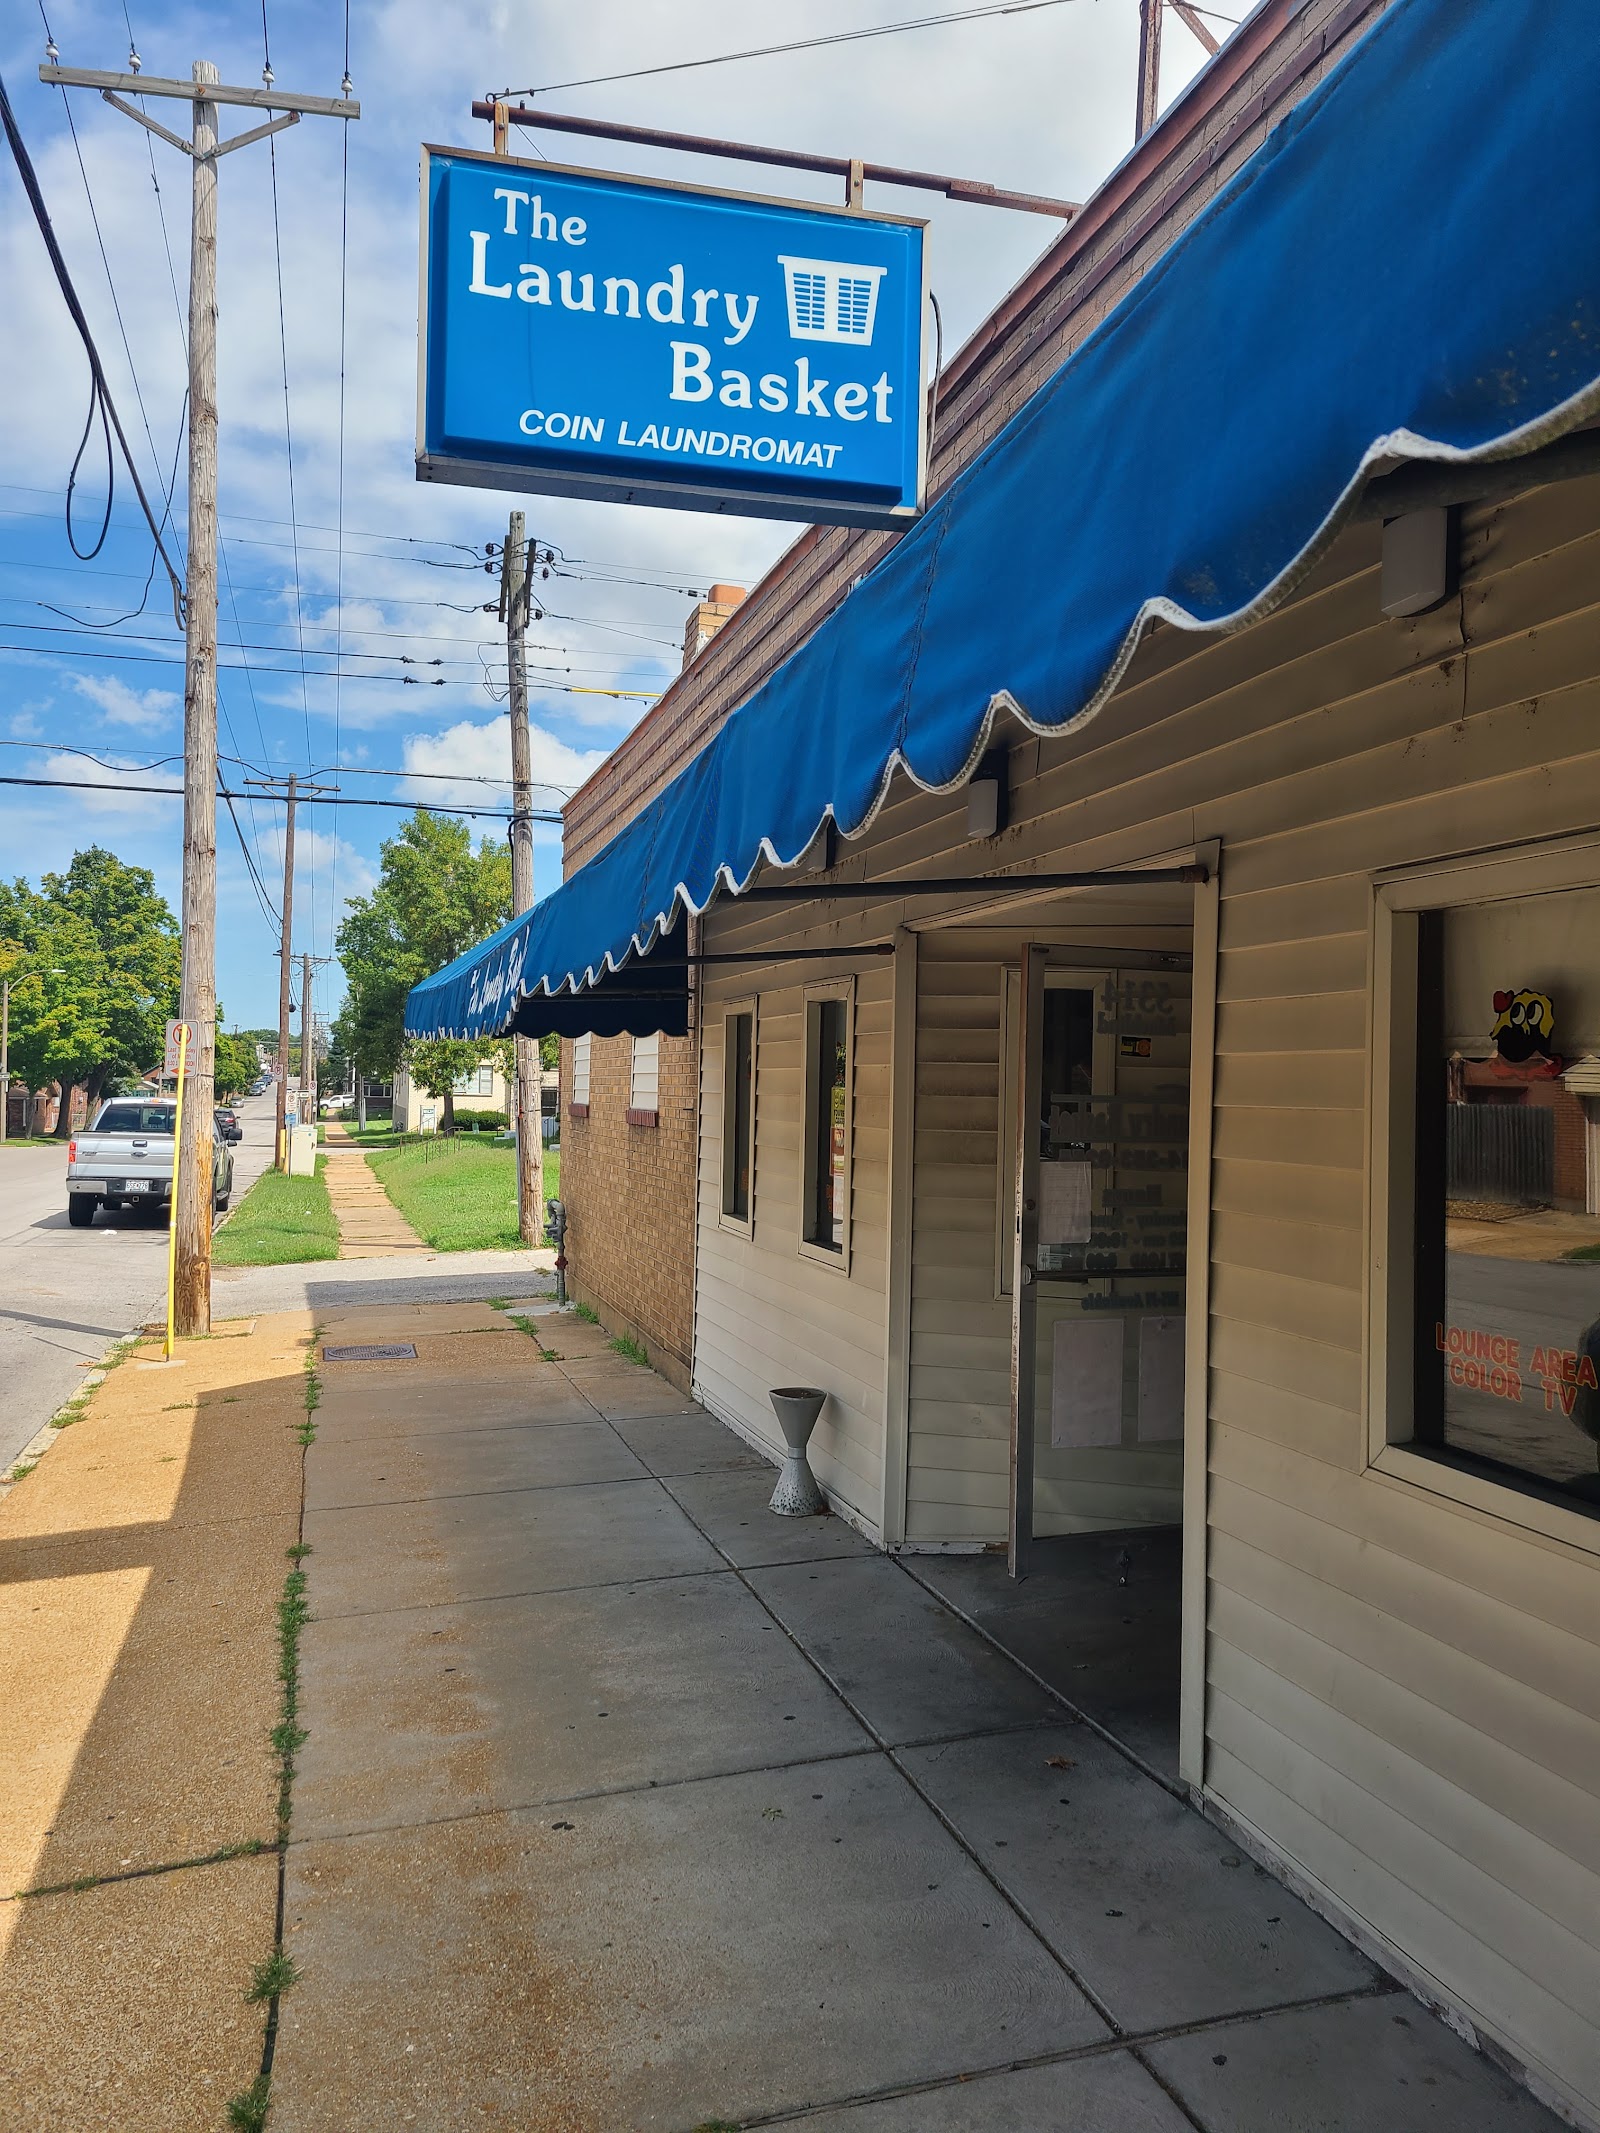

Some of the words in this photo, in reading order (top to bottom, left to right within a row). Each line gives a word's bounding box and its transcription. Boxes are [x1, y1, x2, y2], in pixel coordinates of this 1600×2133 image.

[494, 188, 587, 246] The
[468, 230, 760, 346] Laundry
[668, 340, 894, 424] Basket
[519, 408, 605, 442] COIN
[617, 420, 843, 469] LAUNDROMAT
[1435, 1321, 1520, 1369] LOUNGE
[1529, 1344, 1598, 1390] AREA
[1449, 1356, 1523, 1403] COLOR
[1541, 1379, 1577, 1417] TV
